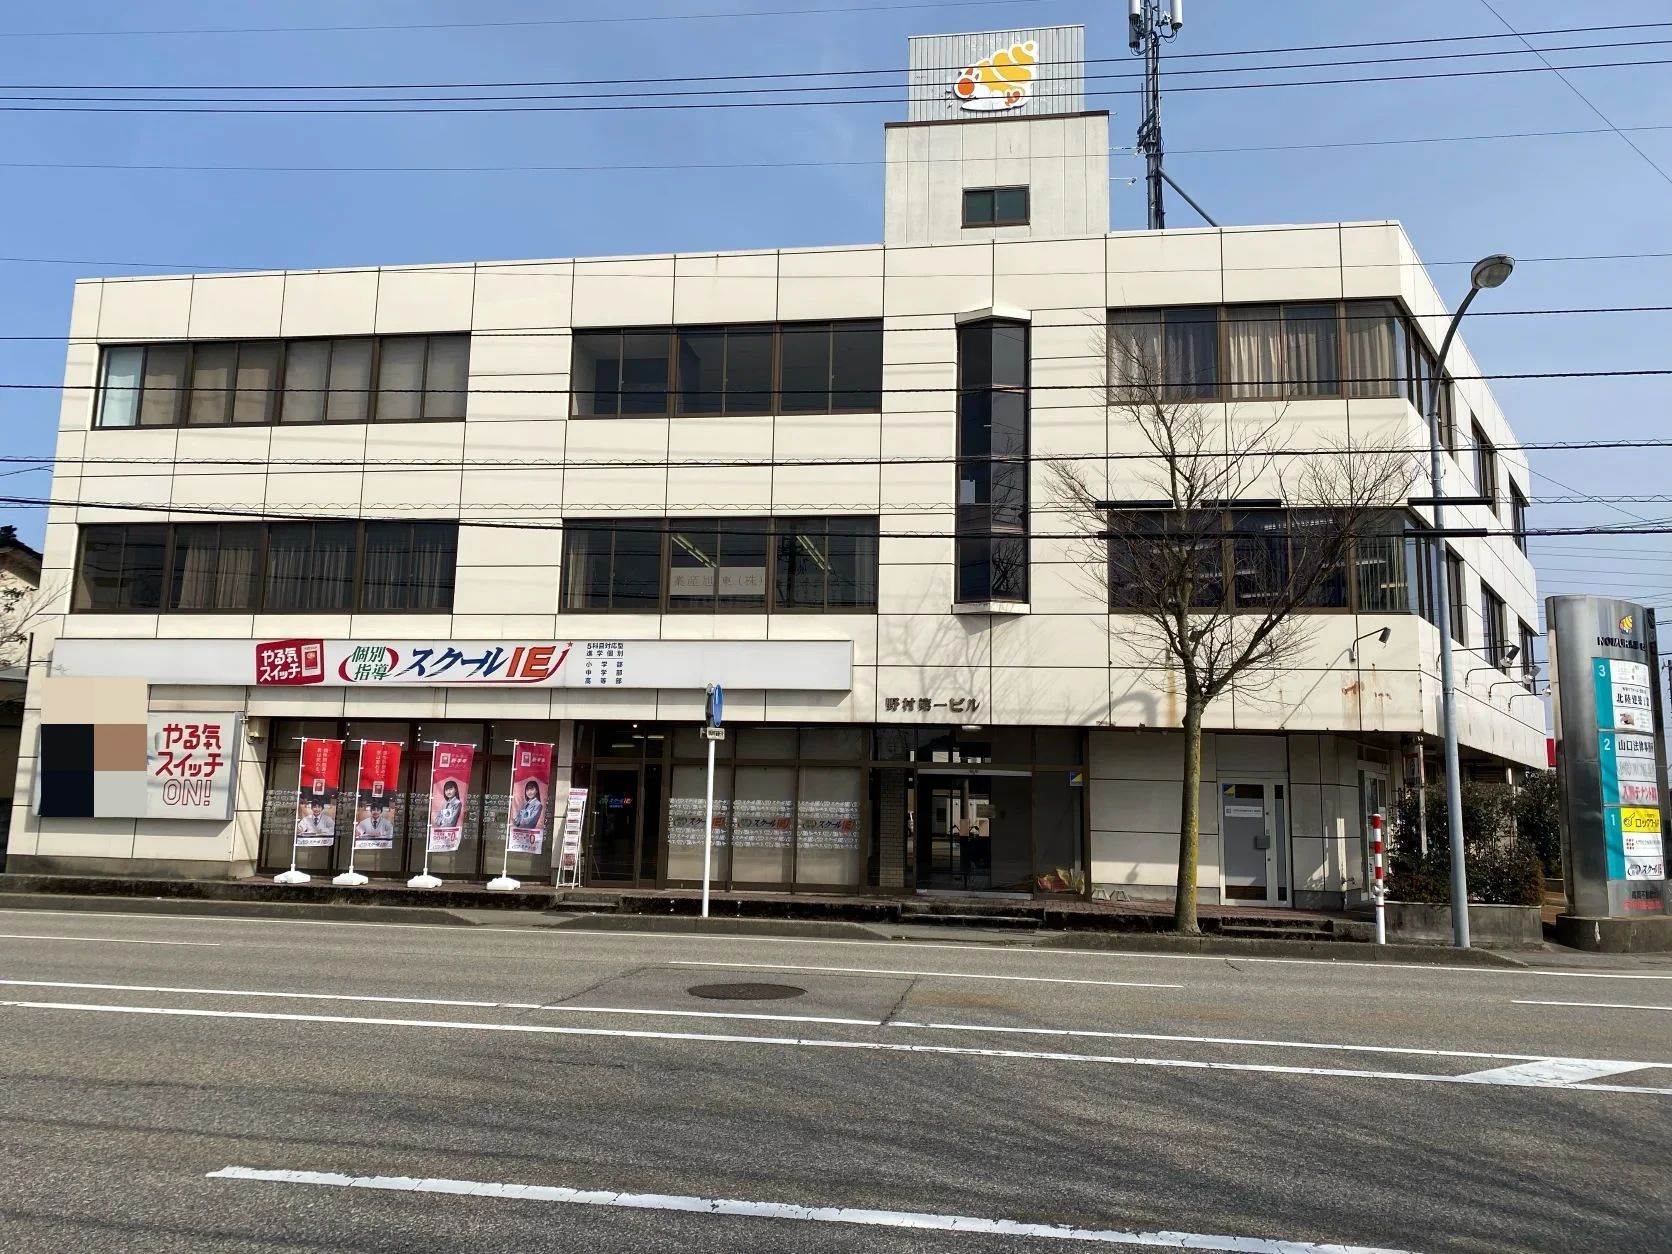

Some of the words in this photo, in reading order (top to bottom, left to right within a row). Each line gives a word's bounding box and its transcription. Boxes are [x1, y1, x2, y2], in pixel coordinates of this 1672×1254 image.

[261, 647, 298, 665] やる気
[352, 645, 386, 663] 個別
[259, 663, 300, 682] スイッチ
[354, 663, 389, 681] 指導
[1598, 665, 1606, 677] 3
[885, 697, 980, 713] 野村第一ビル
[163, 724, 221, 750] やる気
[1603, 739, 1611, 750] 2
[155, 752, 224, 777] スイッチ
[163, 779, 211, 806] ON!
[1610, 814, 1616, 826] 1
